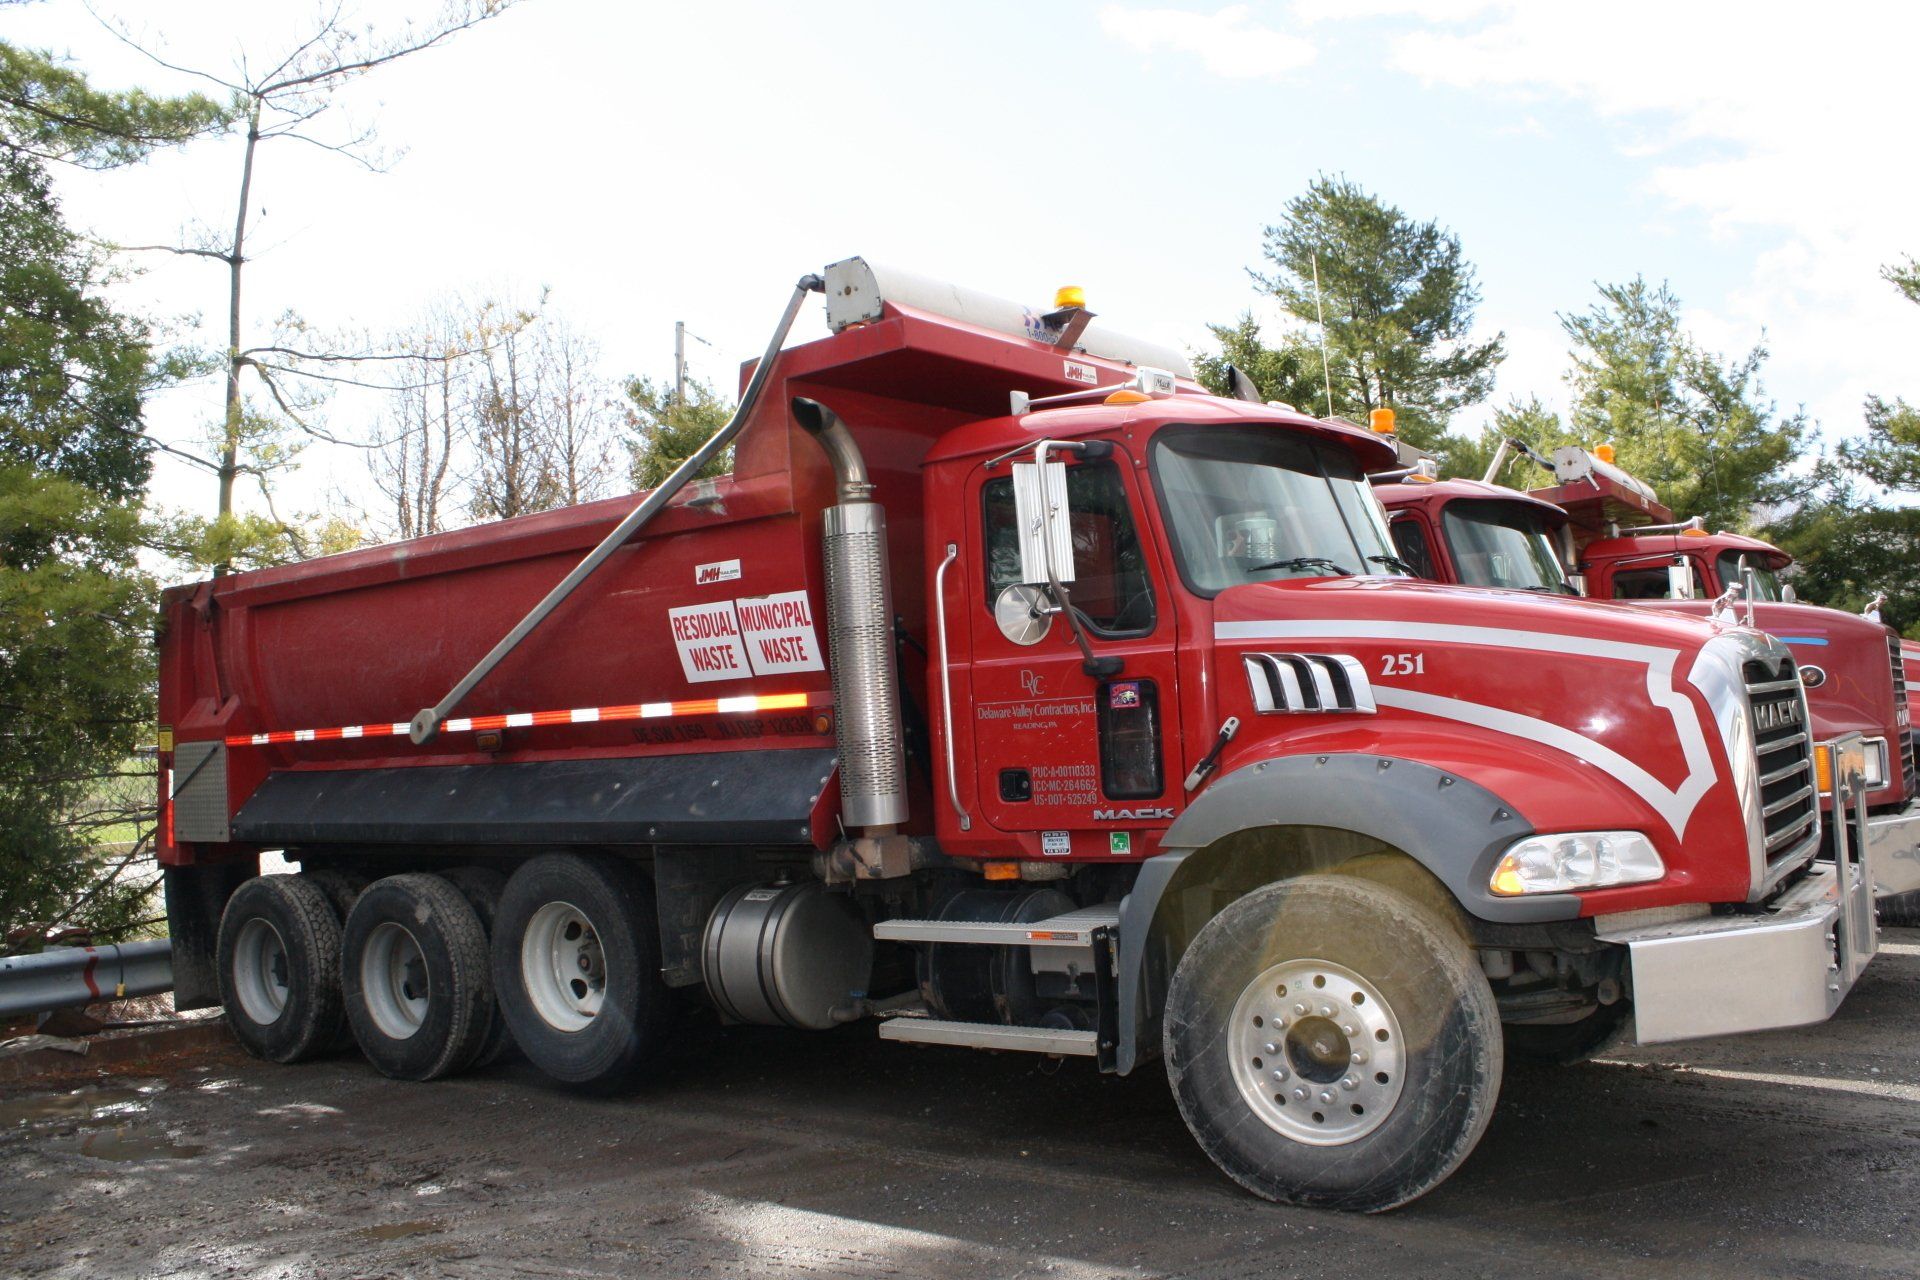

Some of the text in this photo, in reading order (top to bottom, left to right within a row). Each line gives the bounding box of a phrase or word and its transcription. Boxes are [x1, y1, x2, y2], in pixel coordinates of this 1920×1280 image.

[1066, 365, 1083, 380] JMH
[698, 567, 721, 583] JMH
[673, 611, 737, 641] RESIDUAL
[740, 600, 811, 632] MUNICIPAL
[689, 644, 738, 672] WASTE
[759, 636, 808, 664] WASTE
[1381, 652, 1425, 676] 251
[977, 706, 1011, 720] Delaware
[1012, 704, 1034, 720] Valley
[1034, 702, 1080, 716] Contractors,
[1754, 699, 1802, 730] MACK
[1049, 721, 1058, 729] PA
[1093, 808, 1175, 821] MACK
